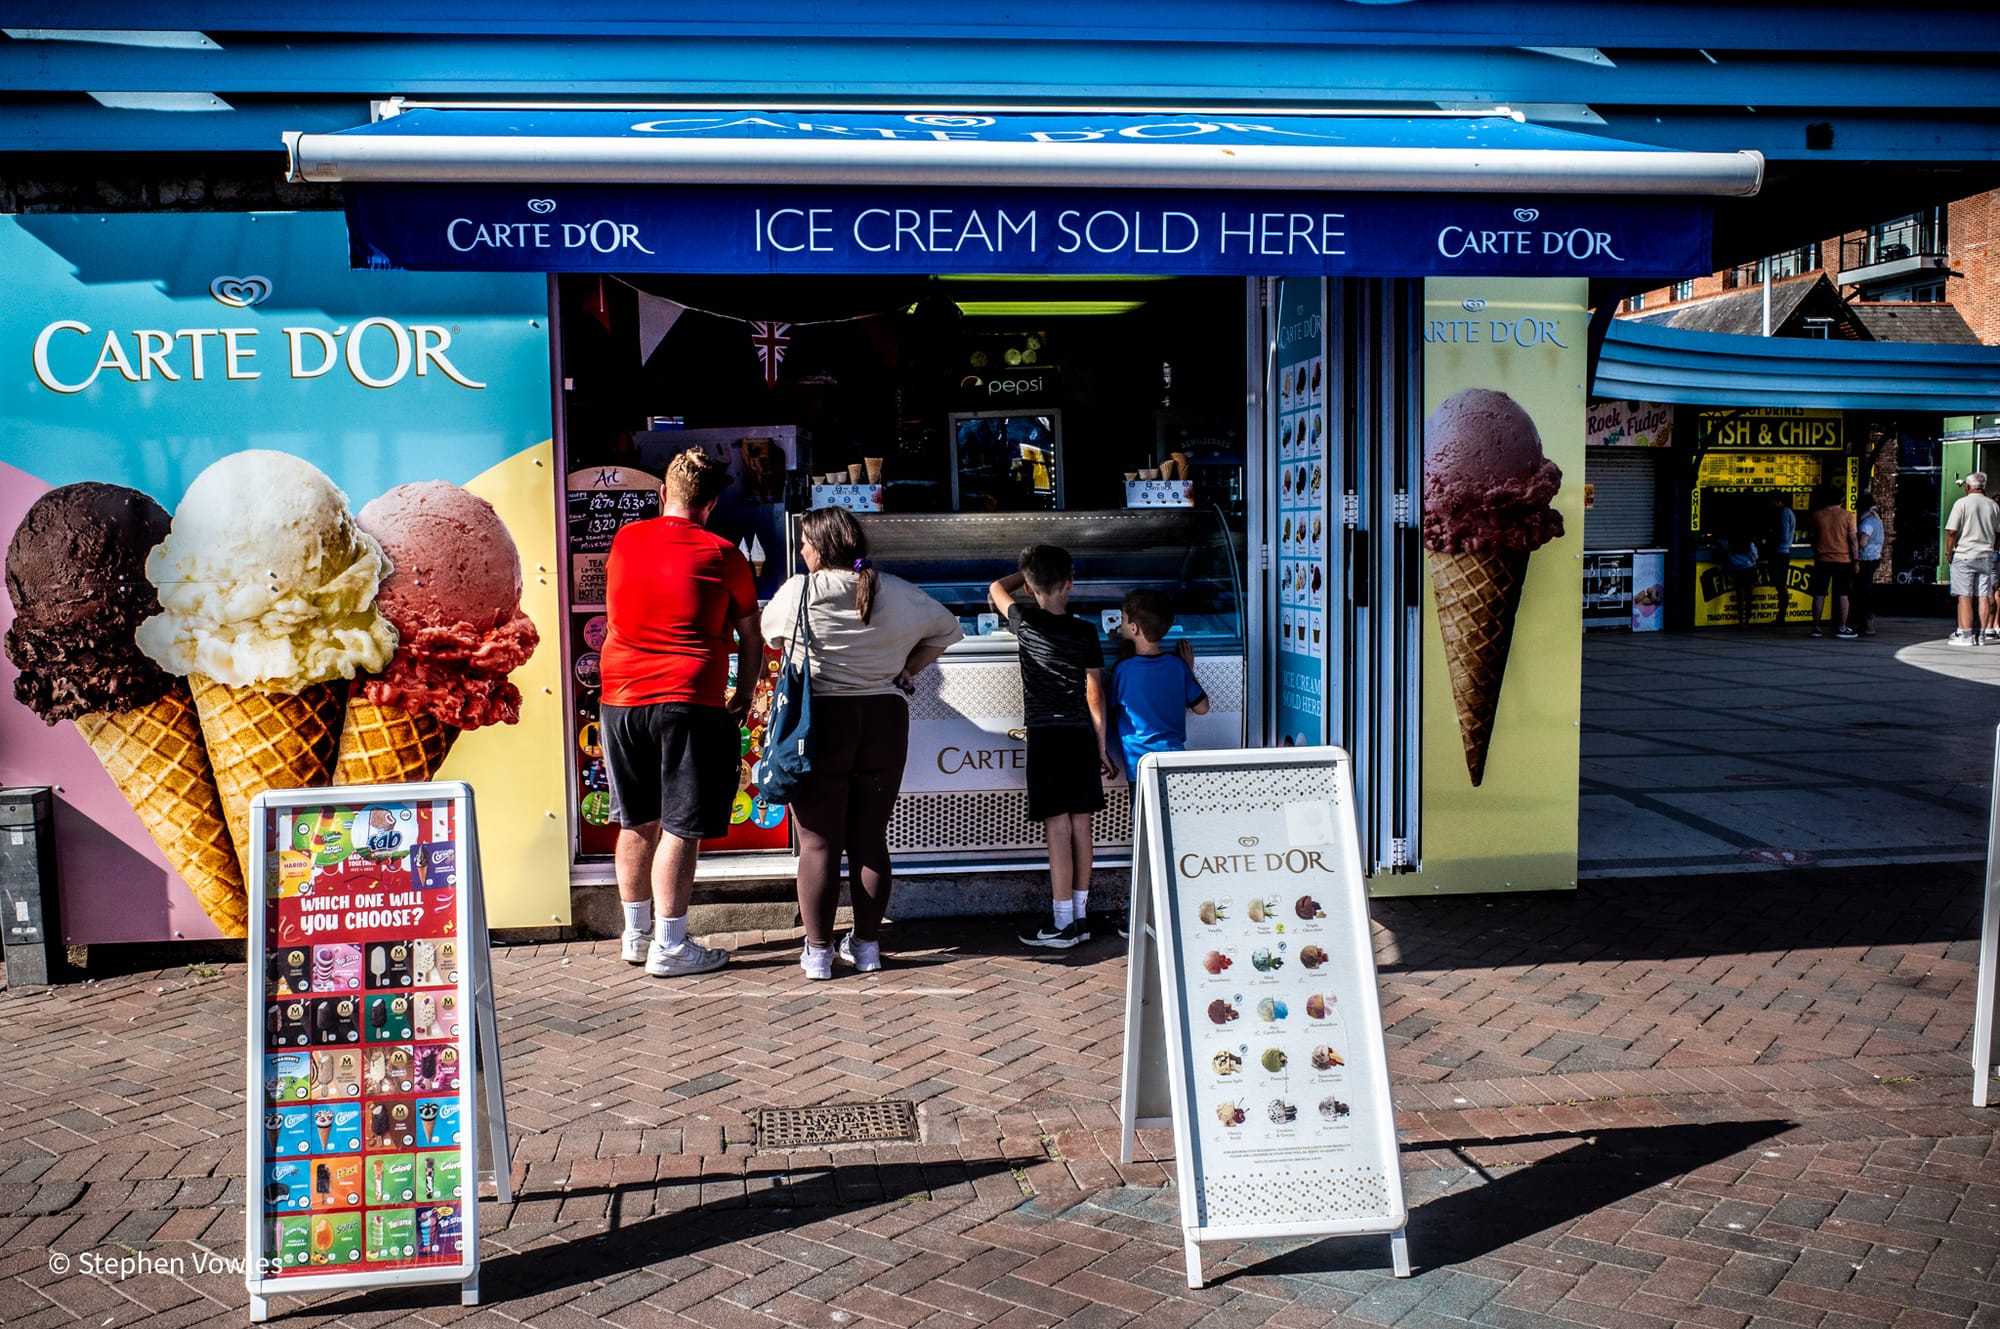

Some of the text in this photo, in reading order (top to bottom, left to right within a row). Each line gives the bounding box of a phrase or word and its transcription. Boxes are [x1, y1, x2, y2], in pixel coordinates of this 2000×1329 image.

[446, 217, 655, 255] CARTE D'OR
[754, 208, 1346, 257] ICE CREAM SOLD HERE
[1437, 225, 1625, 262] CARTE D'OR
[1490, 316, 1569, 349] D'OR
[32, 316, 487, 394] CARTE D'OR
[987, 375, 1043, 398] pepsi
[1587, 407, 1667, 436] Rock Fudge
[1757, 423, 1774, 446] &
[1778, 420, 1837, 446] CHIPS
[617, 496, 645, 511] £3.30
[587, 518, 616, 533] £3.20
[588, 559, 604, 567] TEA
[1283, 670, 1321, 696] ICE CREAM
[1282, 690, 1321, 717] SOLD HERE
[936, 746, 1026, 775] CARTE
[367, 830, 403, 852] fab
[284, 861, 308, 869] HARIBO
[1179, 848, 1335, 879] CARTE D'OR
[300, 890, 424, 912] WHICH ONE WILL
[300, 907, 425, 936] YOU CHOOSE?
